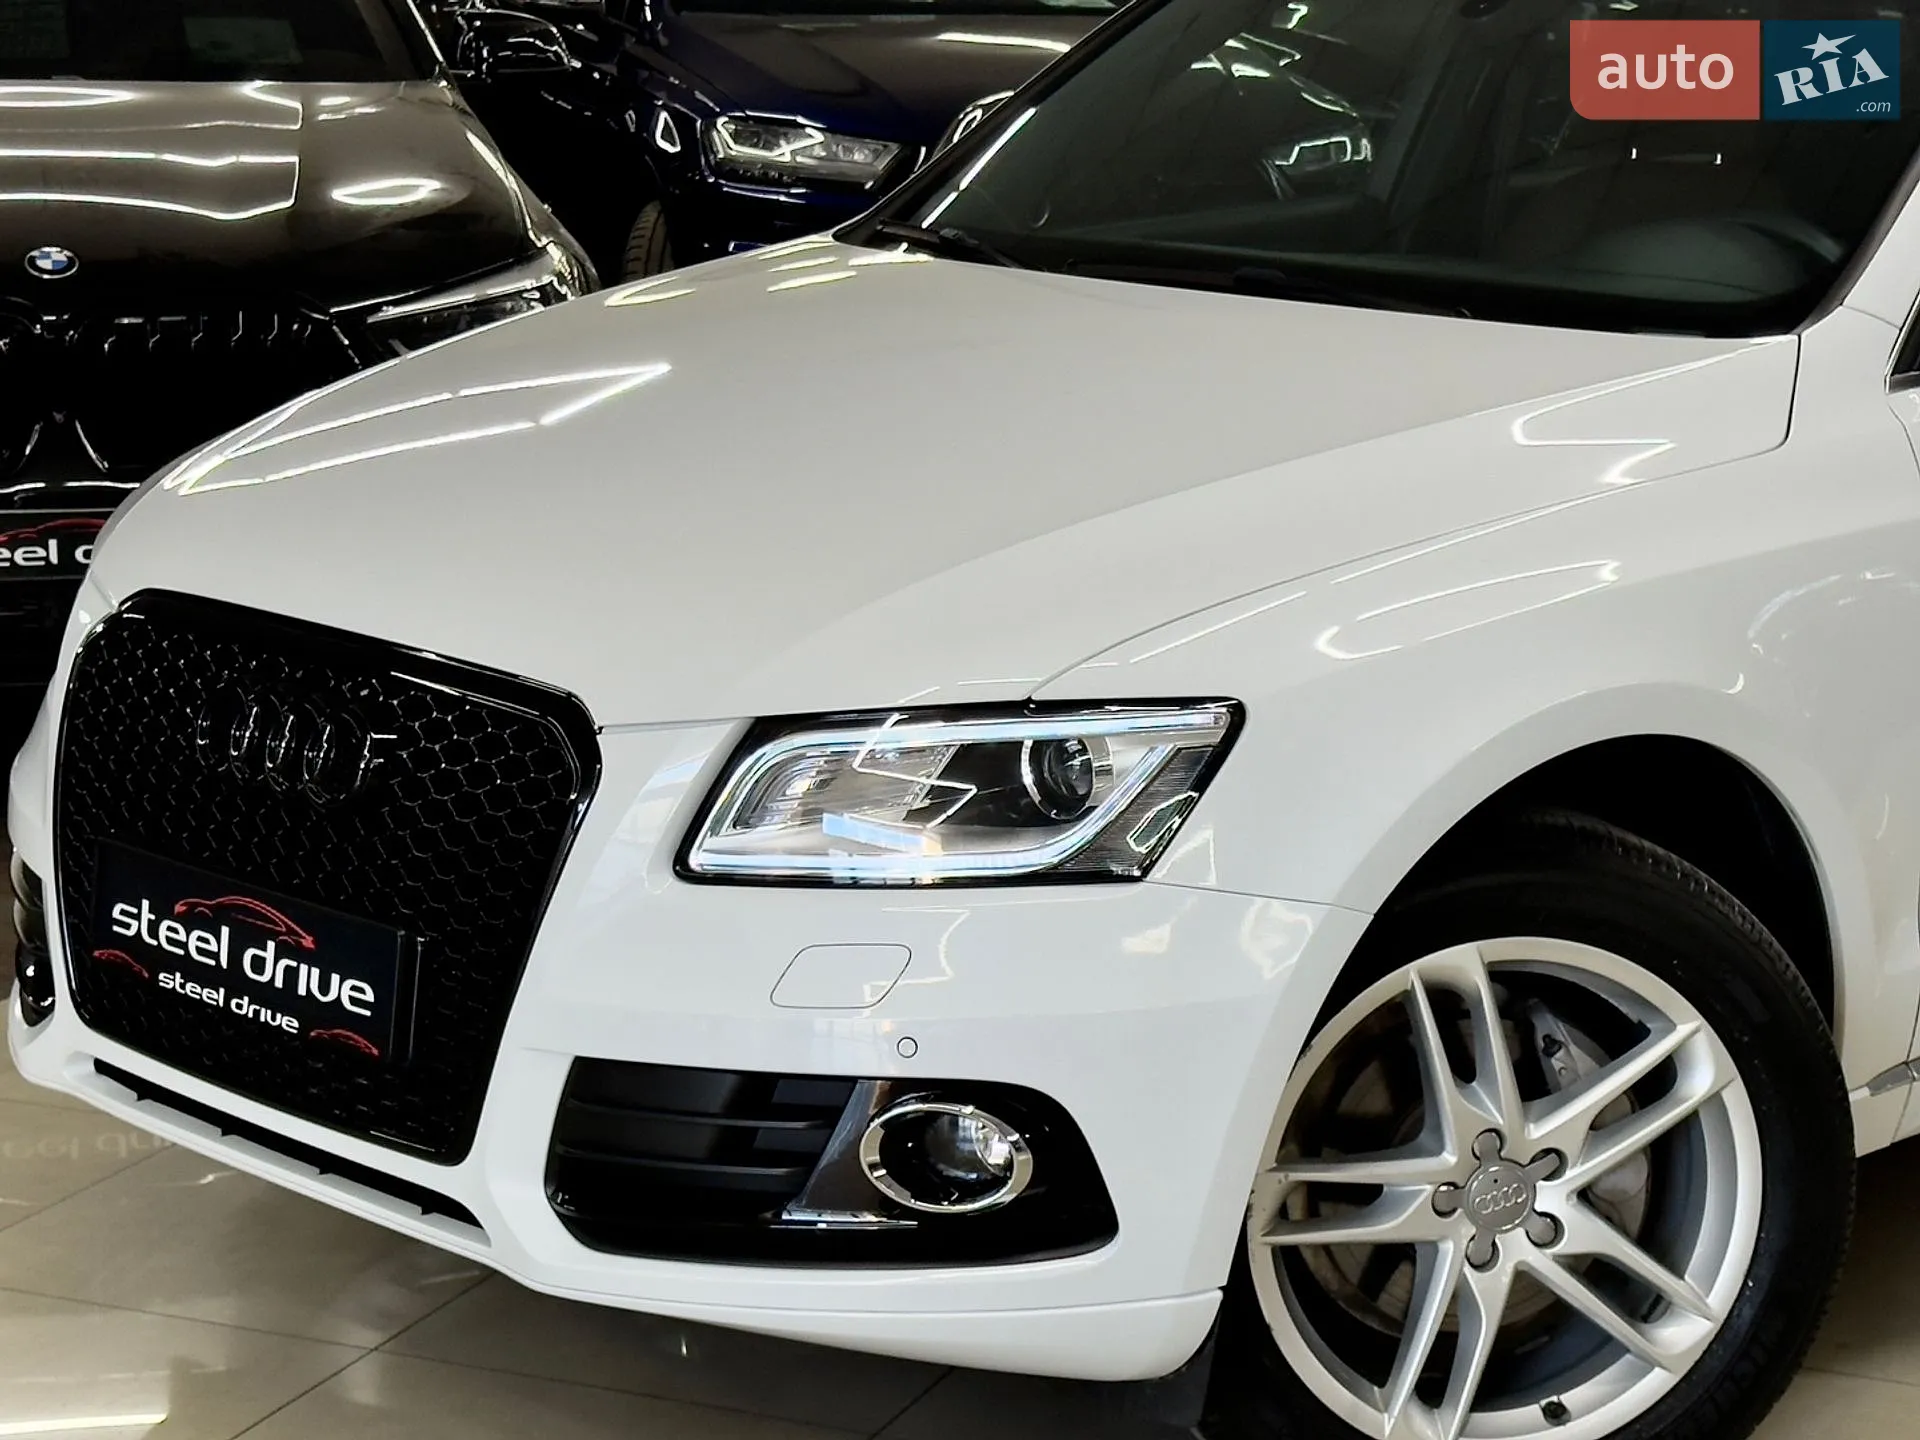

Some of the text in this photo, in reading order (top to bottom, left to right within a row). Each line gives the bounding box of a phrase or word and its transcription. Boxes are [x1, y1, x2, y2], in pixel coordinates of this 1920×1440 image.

[111, 898, 375, 1017] steel drive
[158, 971, 301, 1034] steel drive
